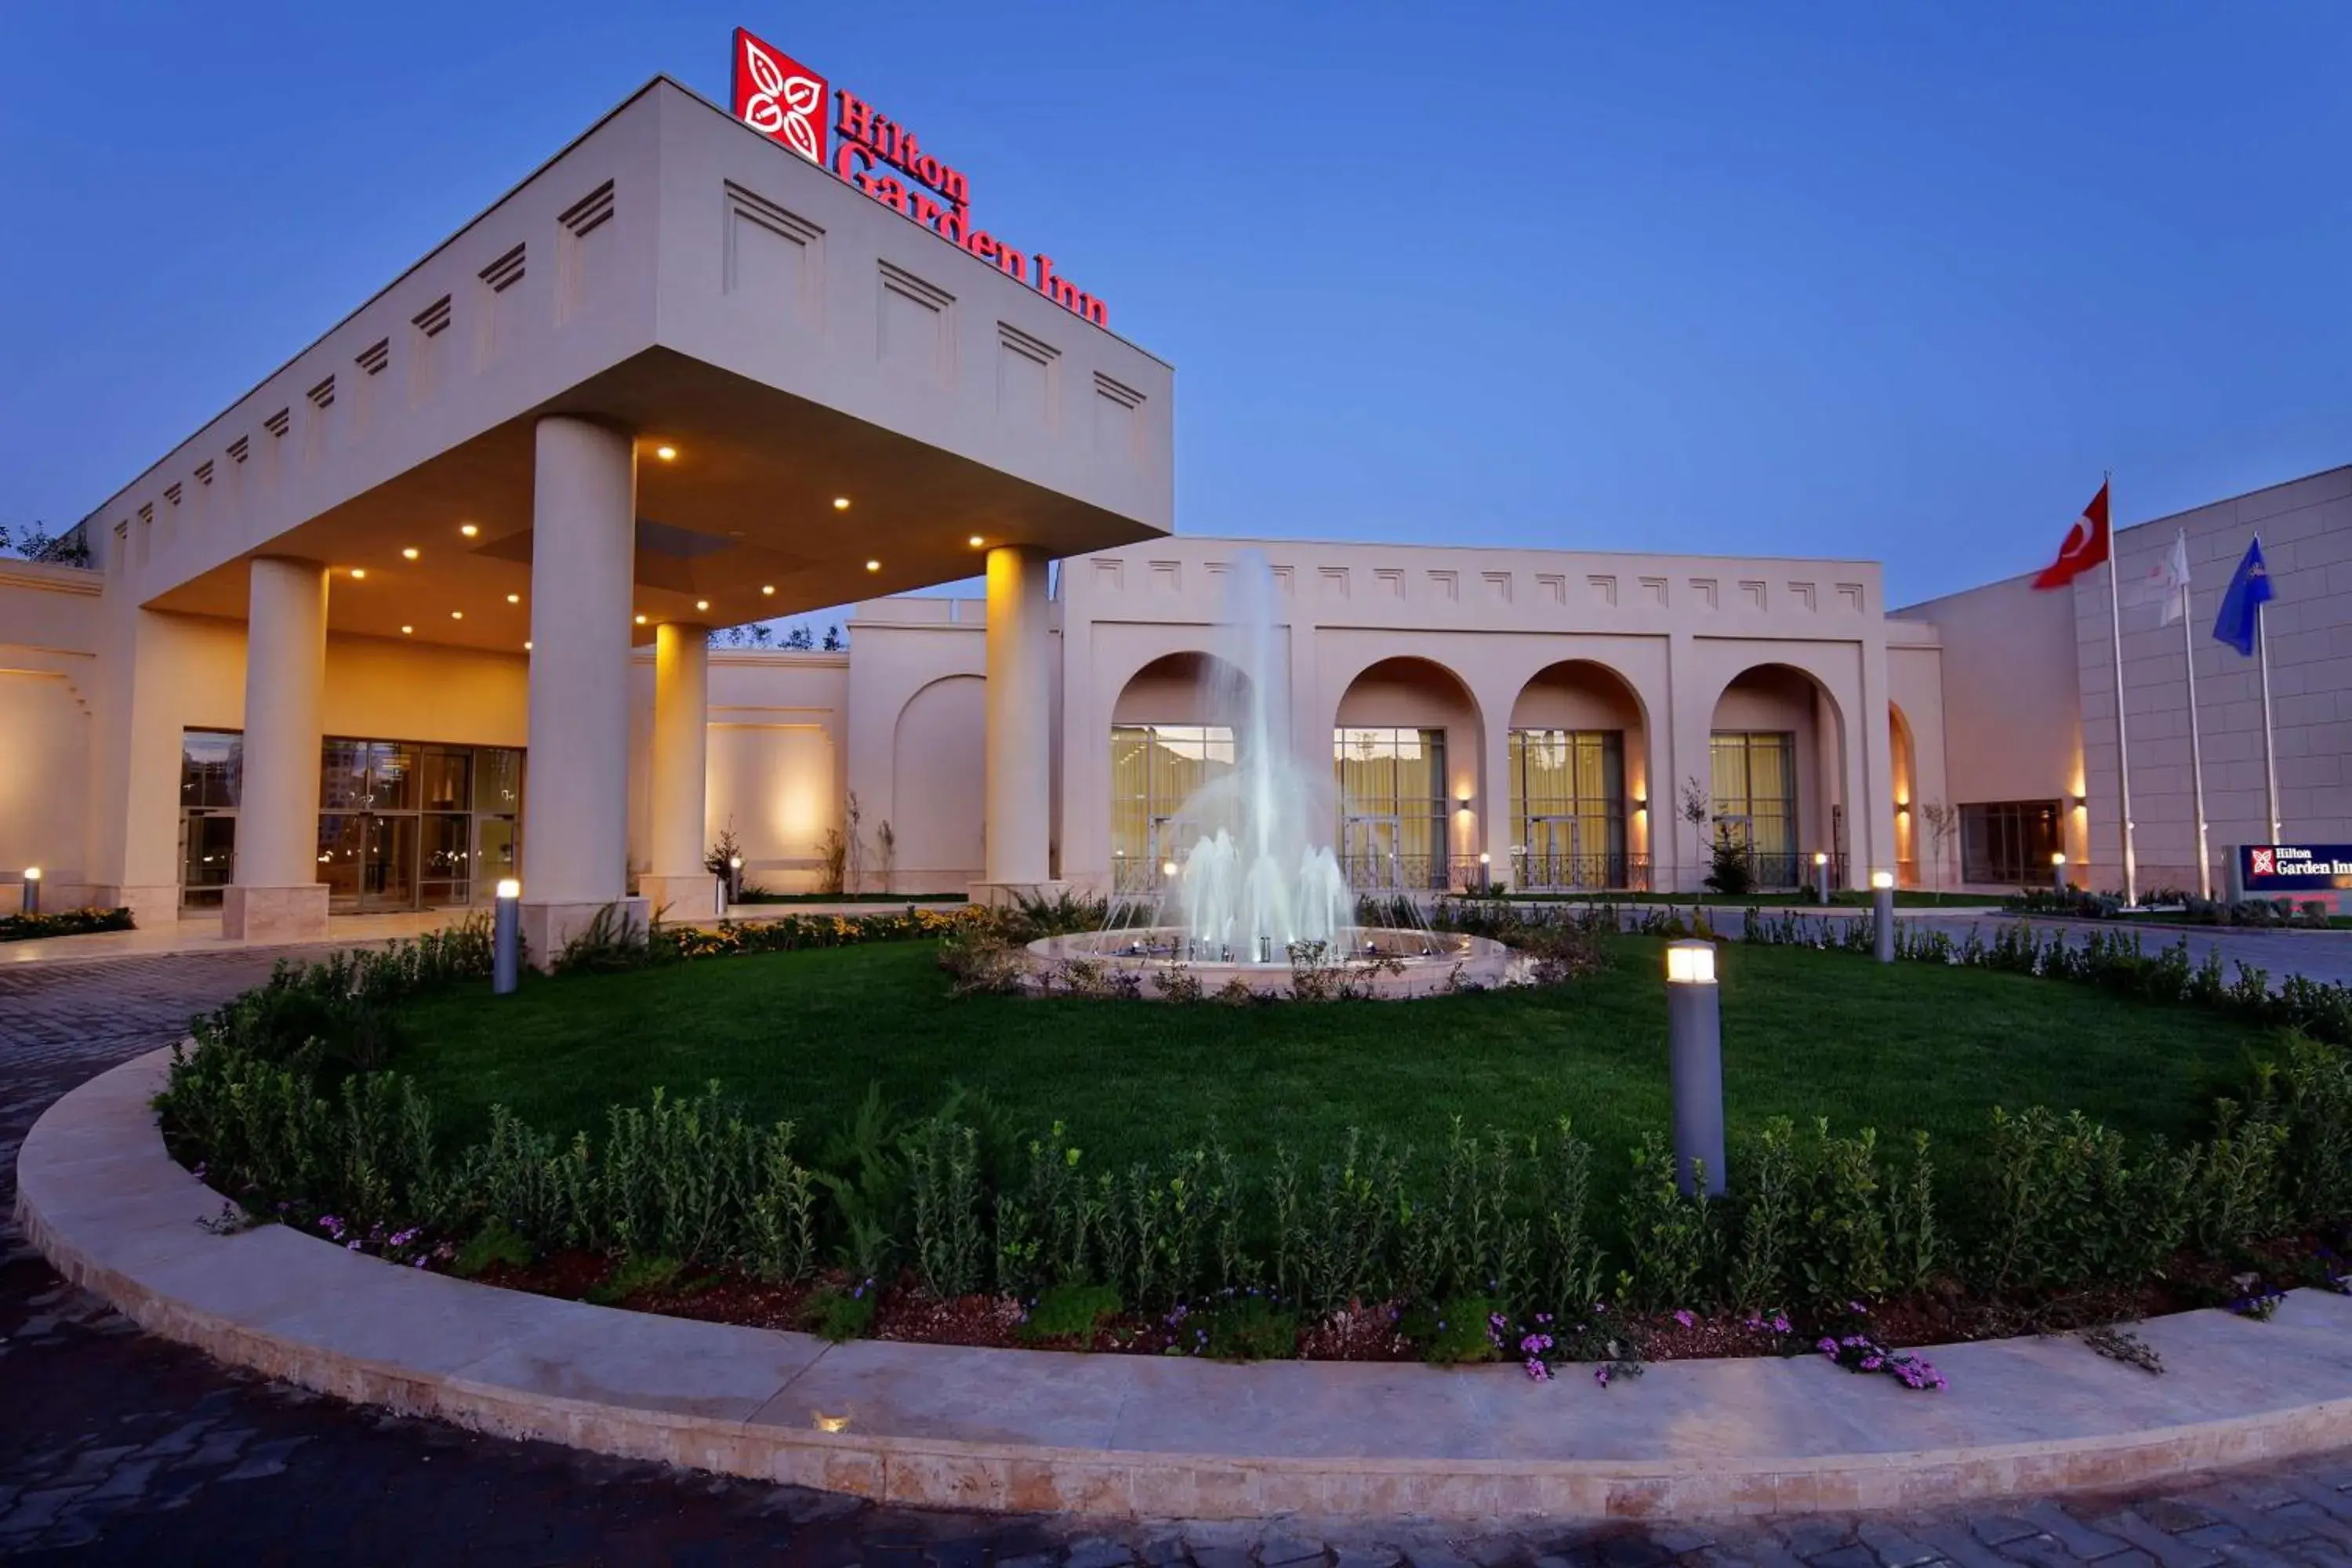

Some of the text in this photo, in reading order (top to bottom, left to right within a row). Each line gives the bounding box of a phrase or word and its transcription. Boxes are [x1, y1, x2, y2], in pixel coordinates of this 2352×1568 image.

[835, 89, 970, 205] Hilton
[833, 141, 1109, 326] Garden Inn
[2276, 848, 2311, 858] Hilton
[2277, 860, 2330, 874] Garden
